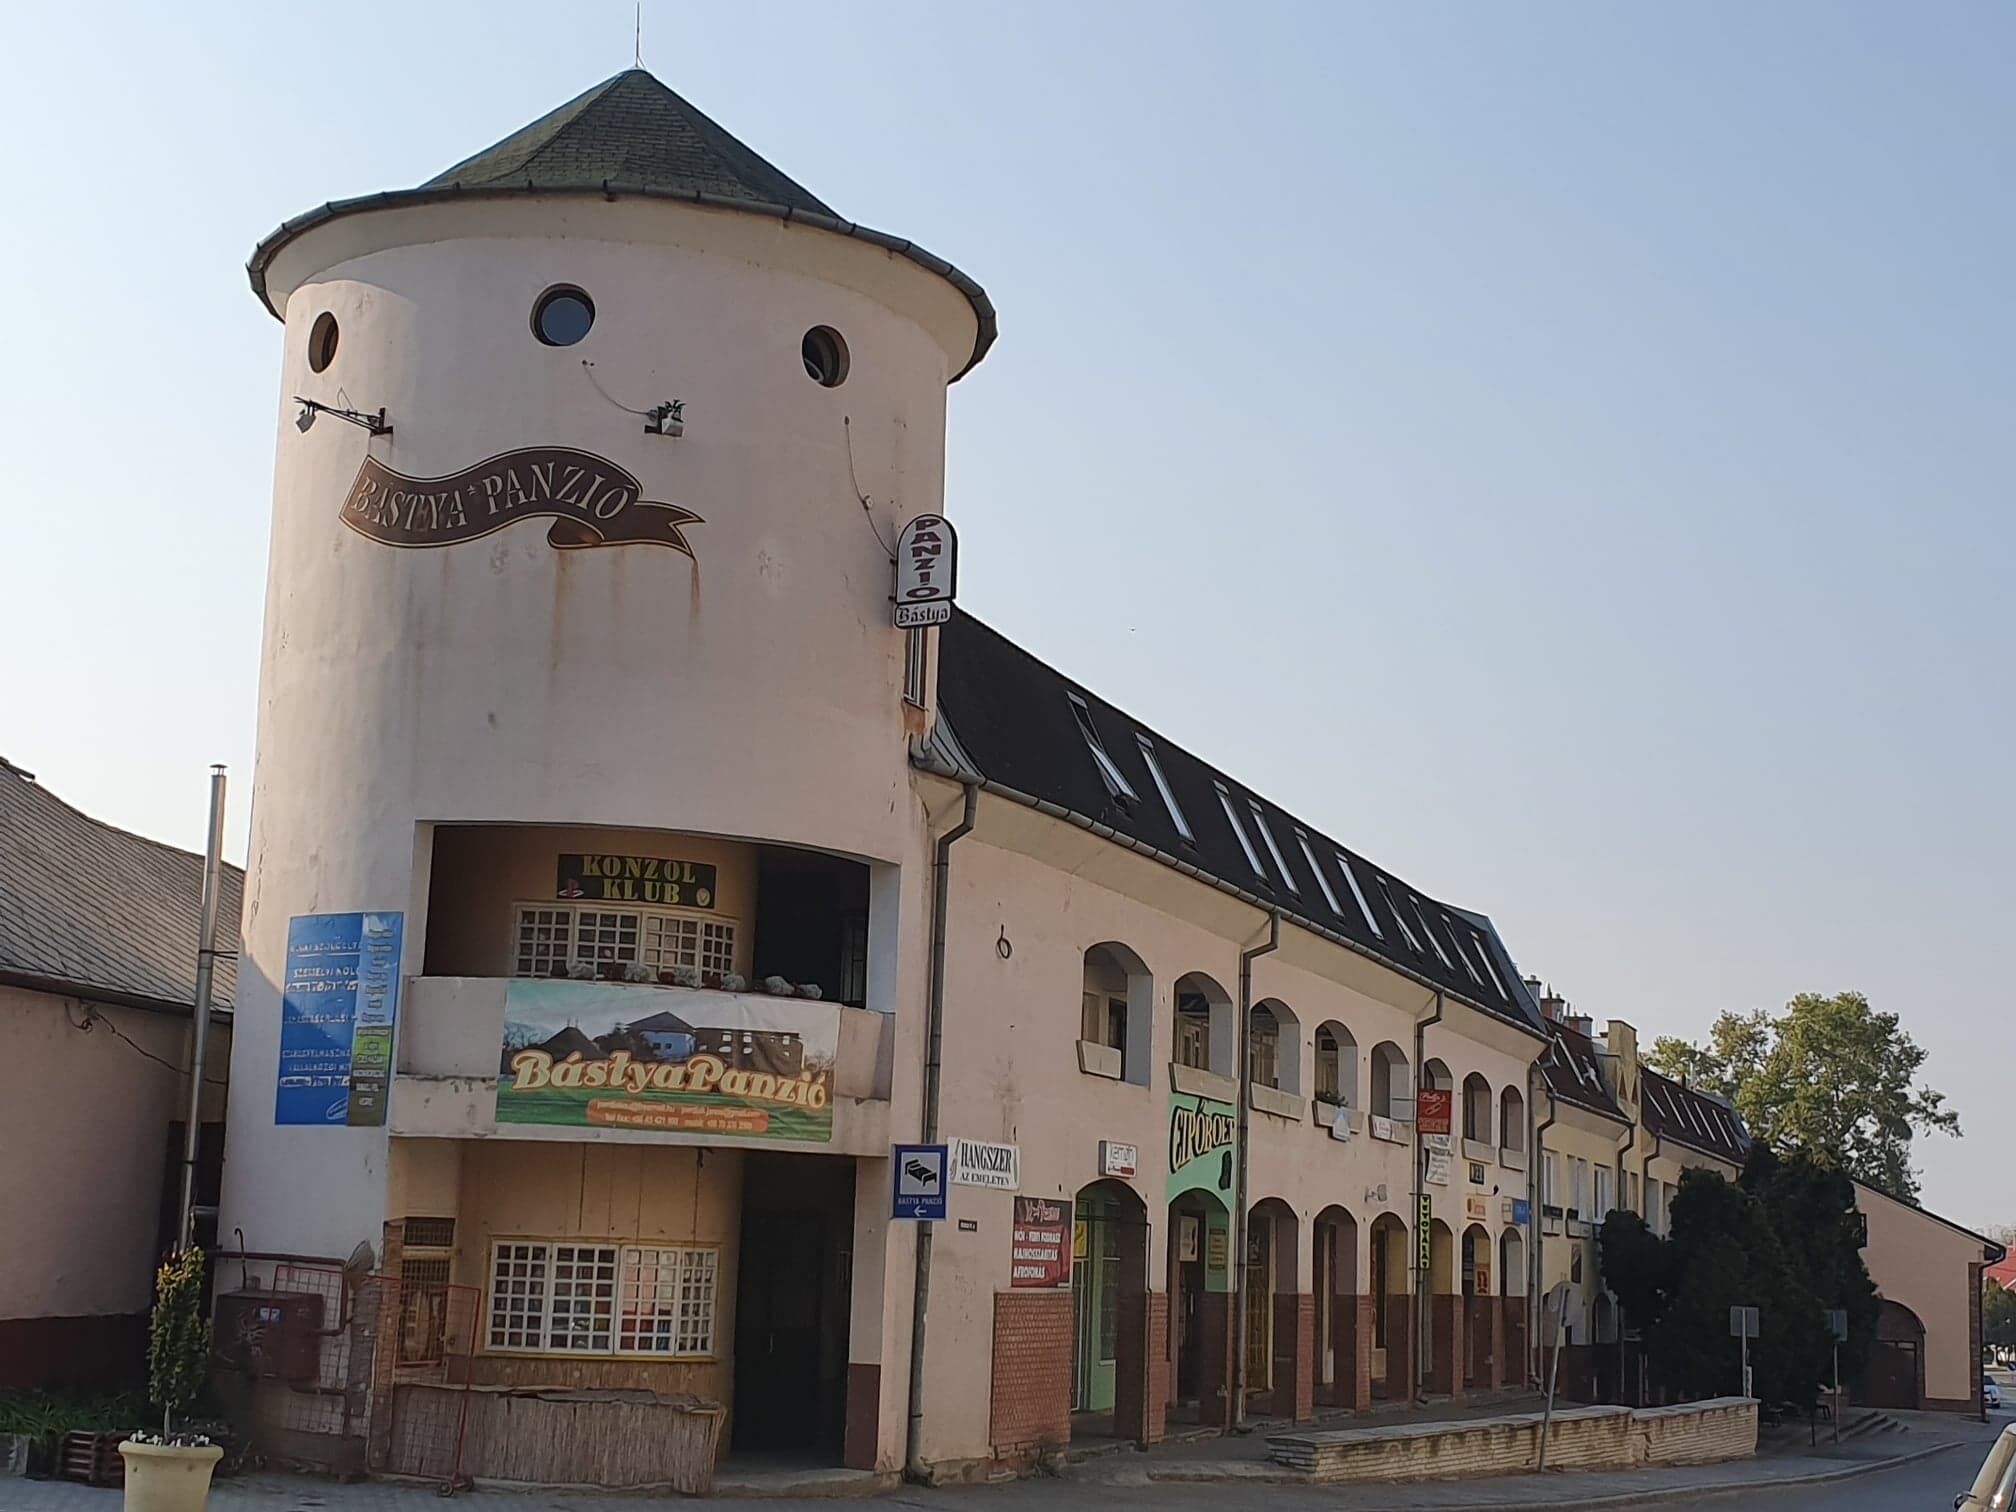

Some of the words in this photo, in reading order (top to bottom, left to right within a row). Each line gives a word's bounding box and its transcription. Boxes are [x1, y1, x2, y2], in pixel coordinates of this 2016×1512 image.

[482, 462, 636, 520] PANZIÓ
[582, 855, 696, 884] KONZOL
[602, 878, 680, 904] KLUB
[960, 1142, 1012, 1174] HANGSZER
[960, 1172, 970, 1182] AZ
